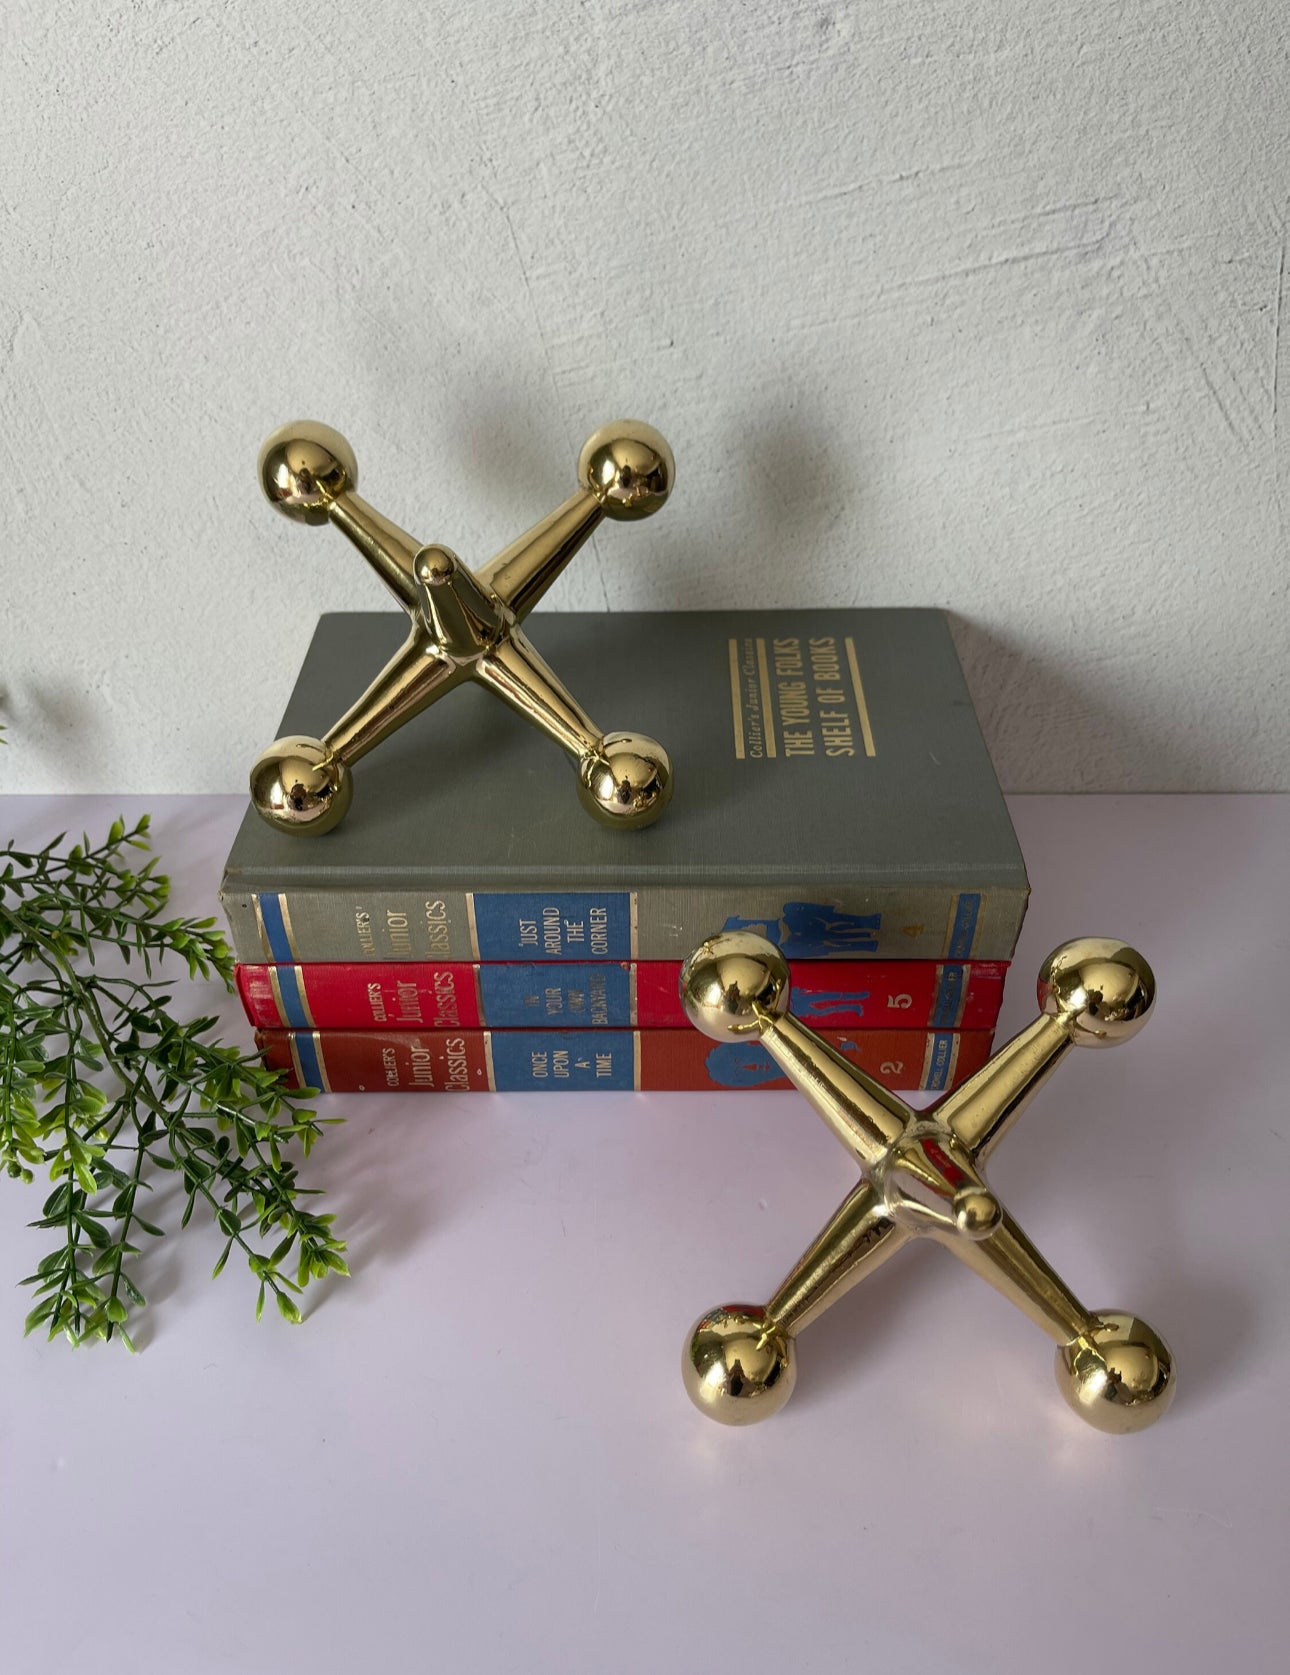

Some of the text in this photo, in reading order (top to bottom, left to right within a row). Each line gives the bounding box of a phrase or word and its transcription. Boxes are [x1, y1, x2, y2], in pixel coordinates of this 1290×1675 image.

[745, 678, 760, 712] Junior
[773, 638, 816, 757] THE YOUNG FOLKS
[808, 636, 856, 757] SHELF OF BOOKS
[519, 919, 538, 946] JUST
[543, 907, 563, 956] AROUND
[565, 920, 584, 943] THE
[589, 907, 609, 955] CORNER
[902, 924, 926, 939] 4
[392, 980, 424, 1024] Junior
[428, 971, 461, 1028] Classics
[545, 987, 564, 1016] YOUR
[887, 993, 914, 1010] 5
[405, 1045, 435, 1088] Junior
[438, 1037, 471, 1092] Classics
[531, 1051, 549, 1079] ONCE
[552, 1050, 570, 1079] UPON
[575, 1058, 591, 1069] A
[595, 1052, 613, 1078] TIME
[880, 1061, 904, 1075] 2
